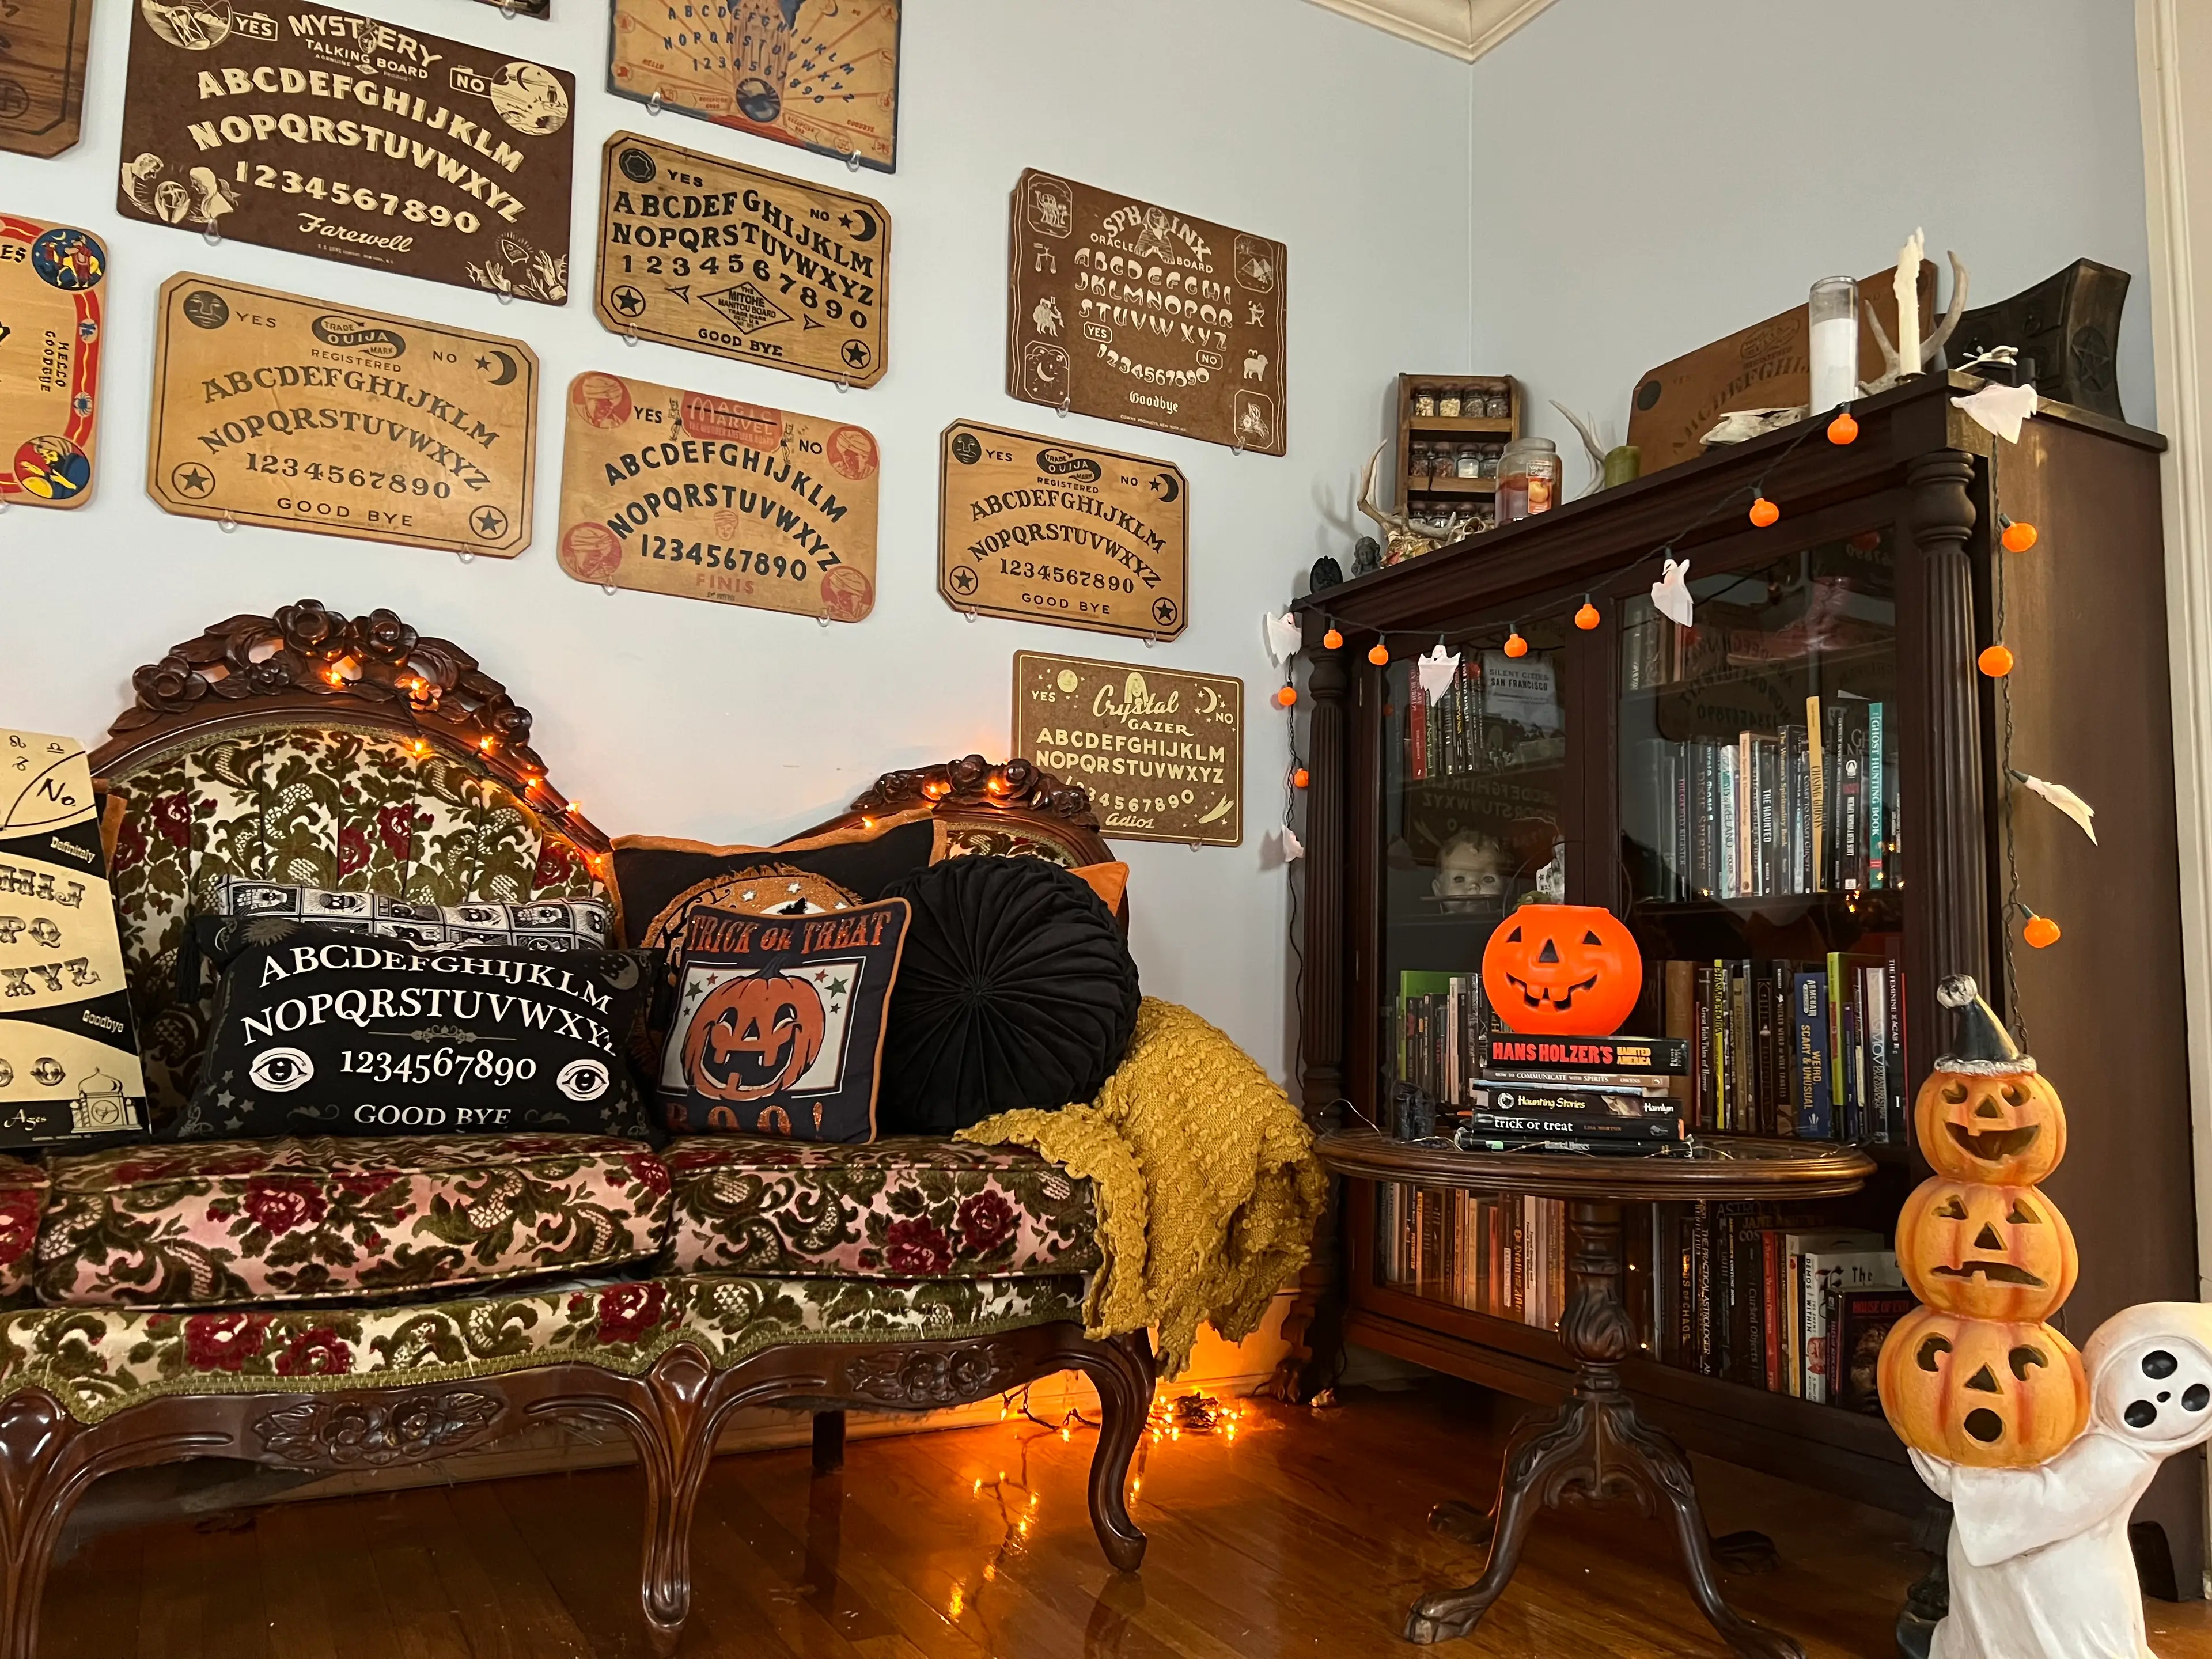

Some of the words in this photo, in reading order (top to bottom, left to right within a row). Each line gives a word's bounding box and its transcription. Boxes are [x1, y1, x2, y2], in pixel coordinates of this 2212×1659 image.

[236, 17, 272, 36] YES
[288, 14, 442, 67] MYSTERY
[306, 39, 370, 63] TALKING
[377, 58, 428, 79] BOARD
[457, 74, 485, 92] NO
[198, 67, 525, 173] ABCDEFGHIJKLM
[187, 113, 526, 224] NOPQRSTUVWXYZ
[666, 169, 703, 187] YES
[236, 161, 480, 233] 1234567890
[810, 208, 830, 222] NO
[298, 212, 413, 252] Farewell
[613, 190, 873, 279] ABCDEFGHIJKLM
[1103, 206, 1211, 262] SPHINX
[0, 244, 26, 263] ES
[611, 221, 873, 307] NOPQRSTUVWXYZ
[1090, 233, 1134, 252] ORACLE
[1177, 256, 1213, 274] BOARD
[741, 286, 754, 294] THE
[1074, 248, 1231, 305] ABCDEFGHI
[718, 298, 750, 312] MANITOU
[752, 306, 776, 318] BOARD
[729, 289, 765, 308] MITCHE
[1075, 272, 1233, 328] JKLMNOPQR
[235, 311, 277, 328] YES
[323, 320, 355, 332] TRADE
[1087, 325, 1107, 339] YES
[327, 332, 389, 344] OUIJA
[369, 346, 393, 356] MARK
[698, 328, 742, 347] GOOD
[750, 340, 783, 357] BYE
[56, 342, 69, 388] HELLO
[312, 349, 402, 373] REGISTERED
[433, 351, 457, 364] NO
[1097, 344, 1210, 387] 1234567890
[1202, 356, 1217, 365] NO
[202, 366, 500, 449] ABCDEFGHIJKLM
[634, 406, 662, 423] YES
[1129, 391, 1179, 414] Goodbye
[197, 408, 491, 492] NOPQRSTUVWXYZ
[799, 440, 823, 455] NO
[986, 449, 1013, 461] YES
[1046, 453, 1067, 462] TRADE
[245, 453, 450, 499] 1234567890
[1048, 461, 1089, 473] OUIJA
[605, 441, 848, 523] ABCDEFGHIJKLM
[1037, 476, 1099, 494] REGISTERED
[1120, 476, 1138, 486] NO
[277, 498, 350, 518] GOOD
[368, 510, 413, 527] BYE
[969, 489, 1166, 554] ABCDEFGHIJKLM
[607, 483, 842, 573] NOPQRSTUVWXYZ
[641, 534, 807, 581] 1234567890
[967, 523, 1162, 589] NOPQRSTUVWXYZ
[696, 573, 755, 594] FINIS
[1000, 558, 1134, 593] 1234567890
[1022, 593, 1069, 608] GOOD
[1080, 601, 1110, 615] BYE
[1490, 669, 1519, 678] SILENT
[1522, 672, 1548, 680] CITIES
[1491, 678, 1505, 687] SAN
[1509, 679, 1547, 691] FRANCISCO
[1031, 691, 1056, 702] YES
[1093, 684, 1180, 723] Crystal
[1127, 718, 1194, 737] GAZER
[1215, 712, 1234, 724] NO
[1036, 728, 1225, 763] ABCDEFGHIJKLM
[1872, 718, 1880, 755] GHOST
[1036, 751, 1224, 784] NOPQRSTUVWXYZ
[1872, 757, 1880, 805] HUNTING
[1810, 765, 1822, 798] CHASING
[1763, 789, 1771, 805] THE
[1763, 806, 1771, 843] HAUNTED
[1813, 800, 1823, 828] GHOSTS
[1872, 806, 1880, 837] BOOK
[50, 836, 96, 863] Definitely
[1697, 816, 1706, 870] SPIRITS
[688, 915, 762, 952] TRICK
[760, 927, 795, 951] OR
[801, 911, 892, 955] TREAT
[258, 945, 614, 1014] ABCDEFGHIJKLM
[1806, 980, 1817, 1016] ARMCHAIR
[82, 1010, 124, 1033] Goodbye
[1701, 1007, 1709, 1025] Great
[1493, 1043, 1536, 1060] HANS
[1539, 1044, 1613, 1063] HOLZER'S
[1617, 1047, 1651, 1056] HAUNTED
[1701, 1041, 1710, 1059] Tales
[1801, 1025, 1811, 1054] SCARY
[340, 1047, 536, 1086] 1234567890
[1617, 1056, 1651, 1066] AMERICA
[1701, 1060, 1710, 1069] of
[1802, 1057, 1812, 1065] &
[1516, 1073, 1567, 1081] COMMUNICATE
[1802, 1067, 1813, 1109] UNUSUAL
[354, 1105, 446, 1126] GOOD
[456, 1107, 512, 1126] BYE
[1518, 1095, 1555, 1109] Haunting
[1556, 1097, 1585, 1109] Stories
[1644, 1103, 1674, 1113] Hamlyn
[1495, 1118, 1524, 1129] trick
[1527, 1121, 1540, 1131] or
[1544, 1120, 1573, 1131] treat
[1702, 1248, 1710, 1293] PRACTICAL
[1852, 1267, 1873, 1282] The
[1749, 1288, 1758, 1324] Cursed
[1702, 1294, 1711, 1355] ASTROLOGER
[1749, 1325, 1759, 1363] Objects
